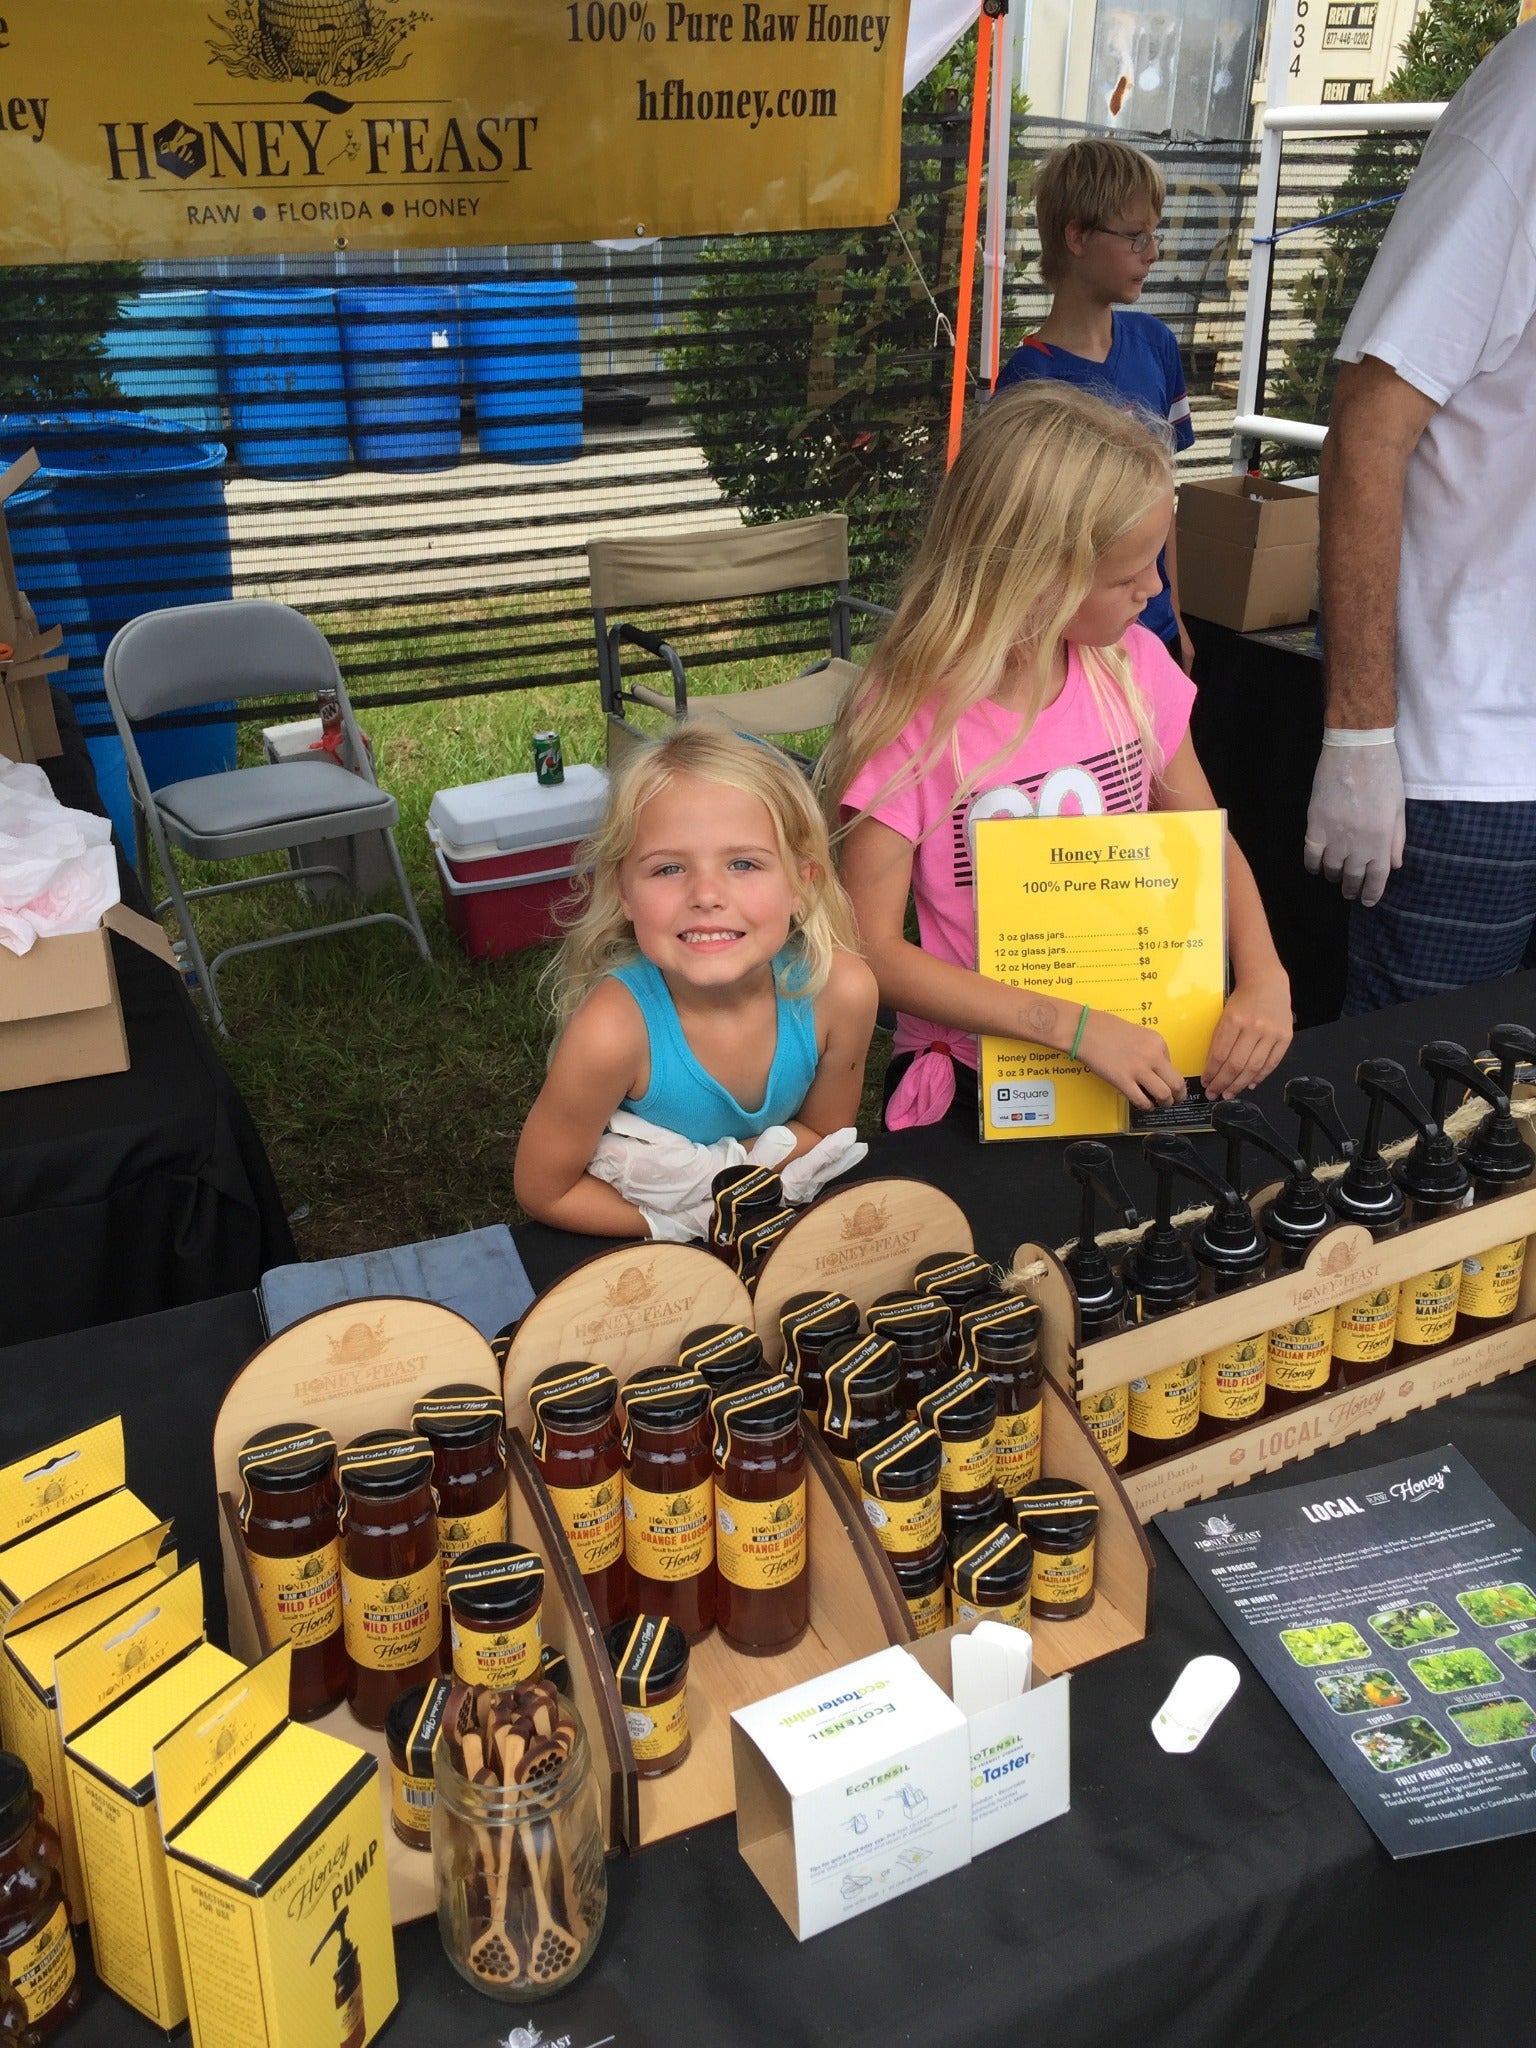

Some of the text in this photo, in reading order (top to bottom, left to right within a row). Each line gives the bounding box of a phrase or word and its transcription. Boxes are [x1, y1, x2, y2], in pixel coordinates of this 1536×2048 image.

[1328, 6, 1376, 26] RENT ME
[567, 1, 890, 52] 100% Pure Raw Honey
[1326, 32, 1370, 46] 877-446-0202
[1324, 82, 1371, 102] RENT ME
[636, 79, 837, 129] hfhoney.com
[99, 116, 538, 180] HONEY FEAST
[187, 197, 481, 226] RAW FLORIDA HONEY
[1050, 844, 1151, 864] Honey Feast
[1022, 876, 1179, 894] 100% Pure Raw Honey
[999, 933, 1005, 942] 3
[1007, 934, 1018, 942] oz
[1019, 932, 1045, 942] glass
[1137, 926, 1149, 936] $5
[994, 948, 1006, 957] 12
[1008, 949, 1019, 957] oz
[1021, 947, 1046, 958] glass
[1138, 941, 1156, 951] $10
[1163, 940, 1169, 949] 3
[1170, 940, 1184, 949] for
[1186, 938, 1203, 949] $25
[995, 963, 1007, 972] 12
[1008, 964, 1020, 972] oz
[1022, 962, 1051, 972] Honey
[1139, 956, 1151, 966] $8
[1023, 977, 1053, 987] Honey
[1055, 976, 1073, 986] Jug
[1140, 971, 1158, 981] $40
[1141, 1001, 1153, 1011] $7
[1141, 1016, 1159, 1026] $13
[997, 1051, 1061, 1063] Honey Dipper
[998, 1069, 1004, 1077] 3
[1019, 1068, 1025, 1077] 3
[1027, 1067, 1050, 1076] Pack
[1052, 1065, 1083, 1076] Honey
[1012, 1089, 1049, 1100] Square
[1340, 1320, 1376, 1332] ORANGE
[1420, 1319, 1453, 1337] Honey
[1357, 1333, 1391, 1353] Honey
[1275, 1367, 1316, 1380] Honey
[1216, 1377, 1239, 1388] WILD
[1224, 1388, 1260, 1409] Honey
[1259, 1388, 1386, 1461] LOCAL Honey
[998, 1466, 1035, 1487] Honey
[1167, 1461, 1199, 1482] Batch
[1163, 1474, 1205, 1500] Crafted
[1301, 1470, 1446, 1525] LOCAL RAW Honey
[641, 1531, 677, 1546] ORANGE
[1233, 1530, 1262, 1543] FEAST
[583, 1533, 621, 1564] Honey
[742, 1543, 780, 1554] ORANGE
[659, 1546, 702, 1571] Honey
[762, 1550, 800, 1578] Honey
[1211, 1561, 1258, 1576] OUR PROCESS
[1037, 1572, 1071, 1584] BRAZILIAN
[277, 1601, 304, 1613] WILD
[1234, 1593, 1279, 1608] OUR HONEYS
[1376, 1598, 1411, 1612] GALLBERRY
[290, 1606, 335, 1638] Honey
[363, 1609, 430, 1634] WILD FLOWER
[1509, 1621, 1529, 1632] PALM
[373, 1636, 422, 1660] Honey
[477, 1651, 527, 1667] WILD FLOWER
[486, 1667, 519, 1682] Honey
[1316, 1661, 1378, 1676] Orange Blossom
[1453, 1690, 1501, 1704] Wild Flower
[1366, 1712, 1394, 1726] TUPELO
[1395, 1773, 1418, 1787] FULLY
[1418, 1761, 1464, 1782] PERMITTED
[1472, 1754, 1494, 1767] SAFE
[287, 1833, 351, 1923] Honey
[331, 1838, 378, 1912] PUMP
